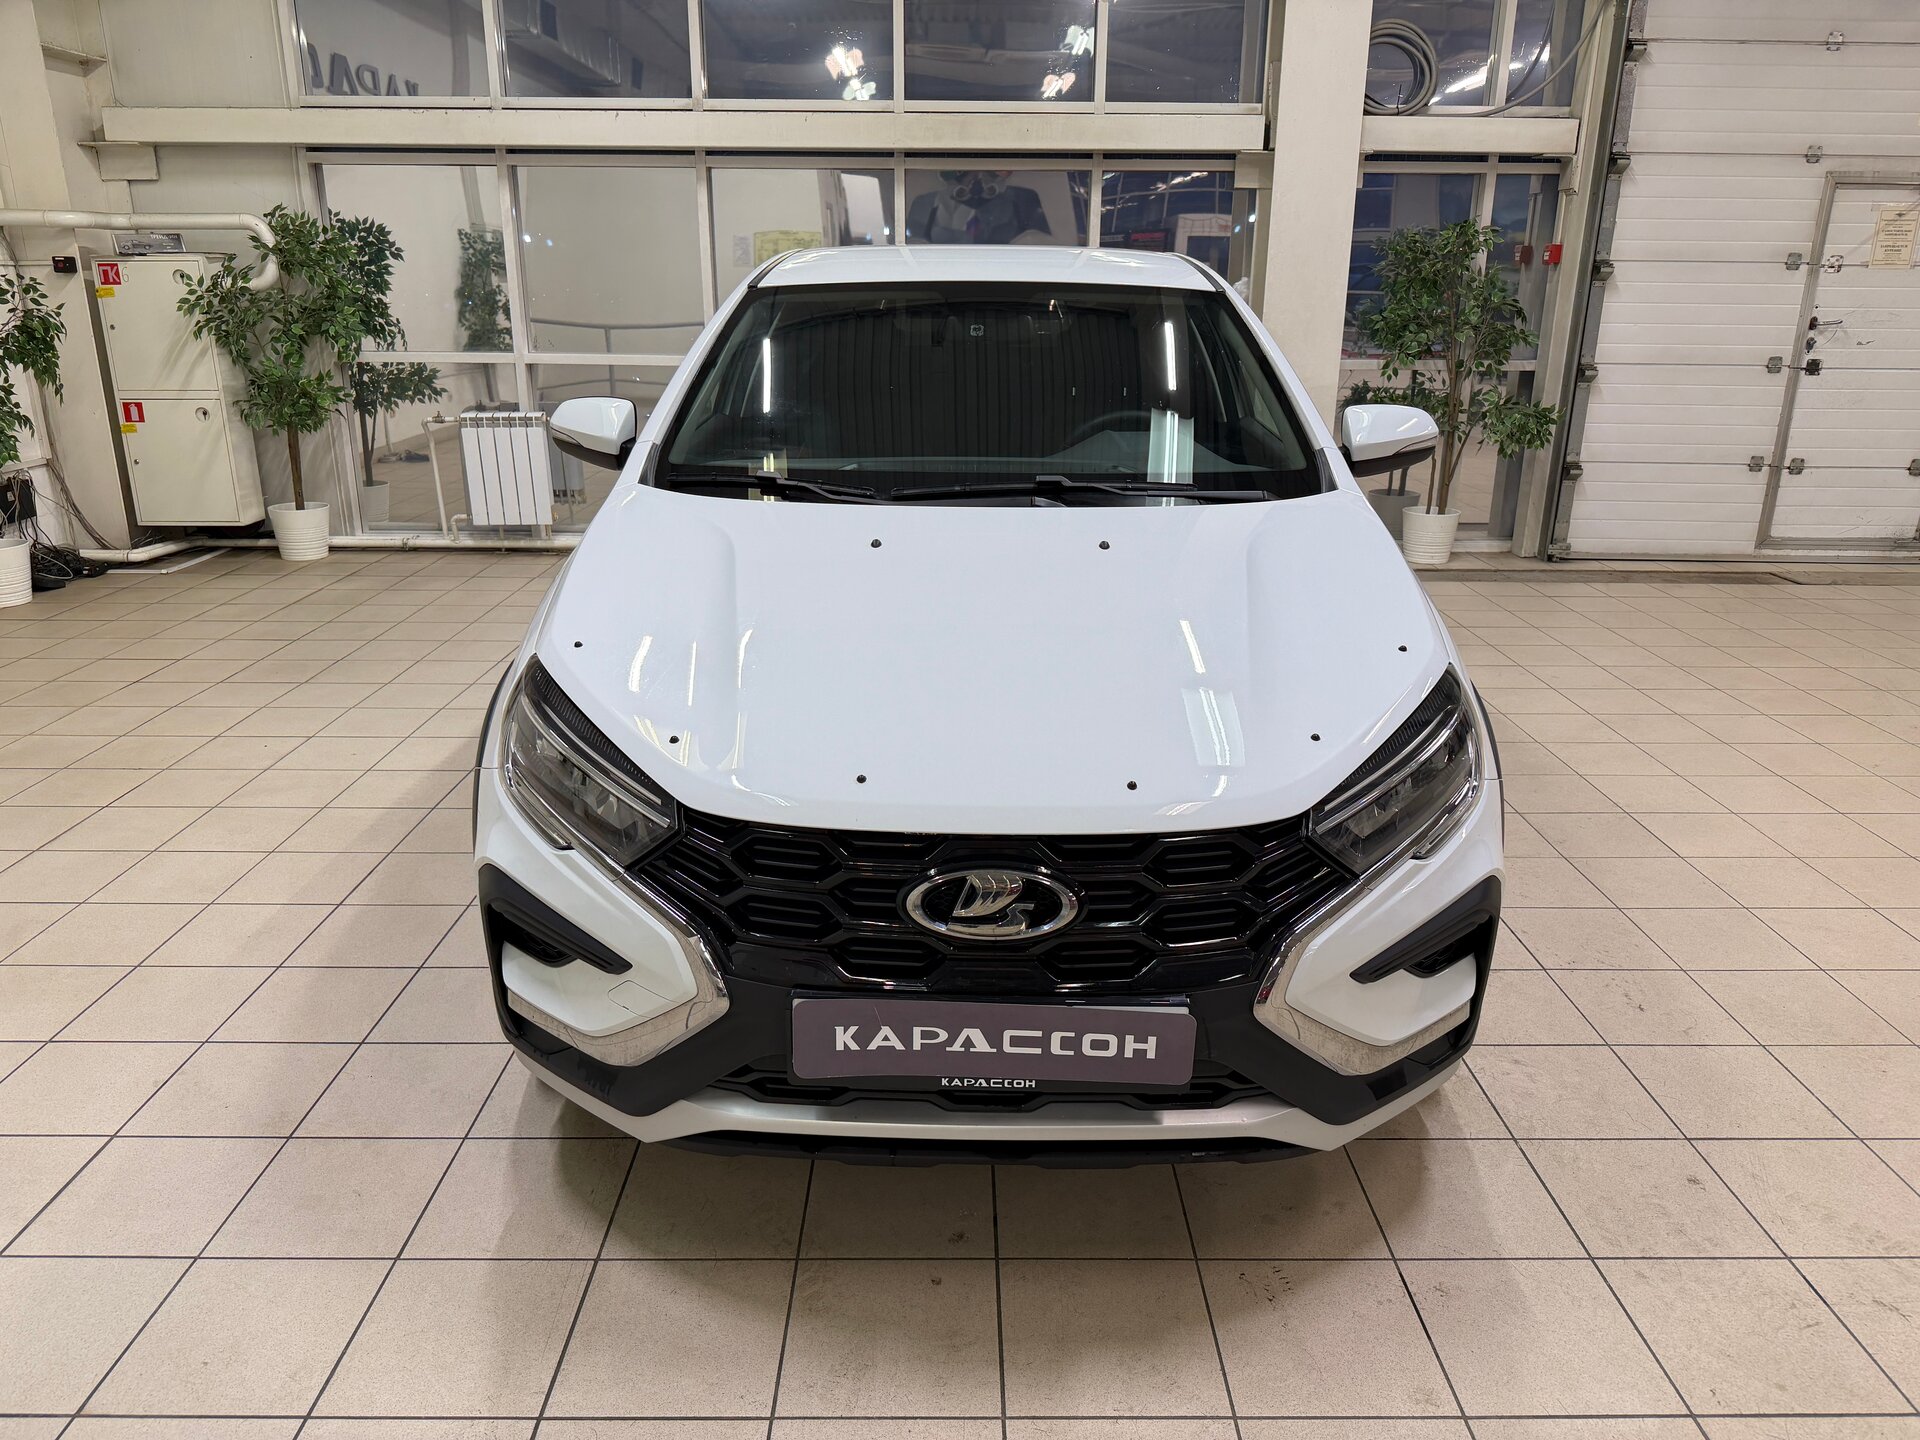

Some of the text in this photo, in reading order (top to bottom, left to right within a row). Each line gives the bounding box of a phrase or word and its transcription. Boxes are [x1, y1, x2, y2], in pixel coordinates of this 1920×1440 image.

[99, 265, 129, 283] ПК 6
[834, 1025, 1157, 1060] КАРАССОН
[941, 1077, 1036, 1088] КАРАССОН
